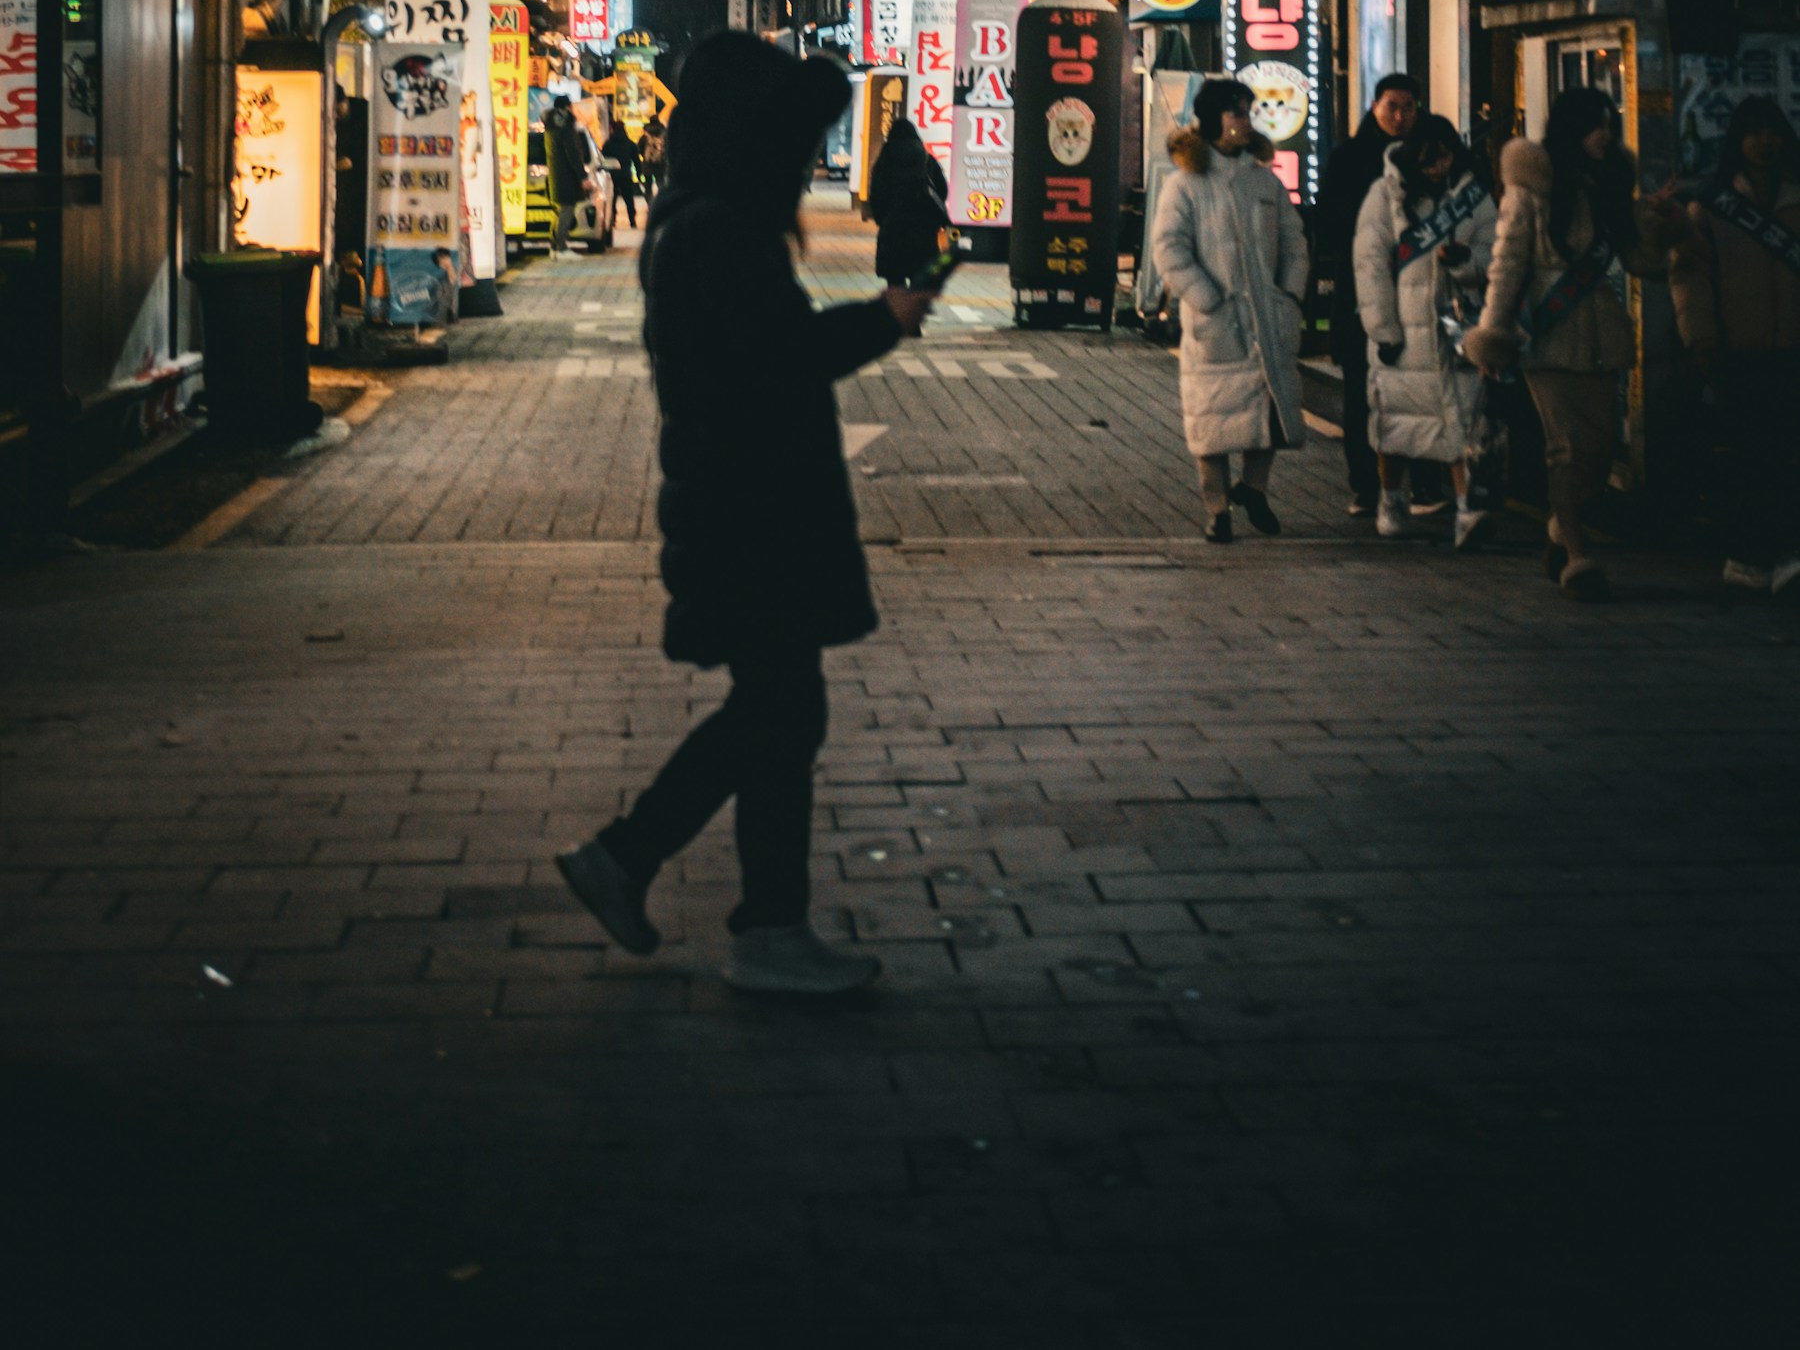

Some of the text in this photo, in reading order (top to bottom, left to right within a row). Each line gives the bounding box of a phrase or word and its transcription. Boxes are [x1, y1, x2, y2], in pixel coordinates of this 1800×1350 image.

[1048, 35, 1098, 85] 냥
[968, 21, 1013, 152] BAR
[967, 191, 1005, 222] 3F
[1042, 176, 1093, 222] 코
